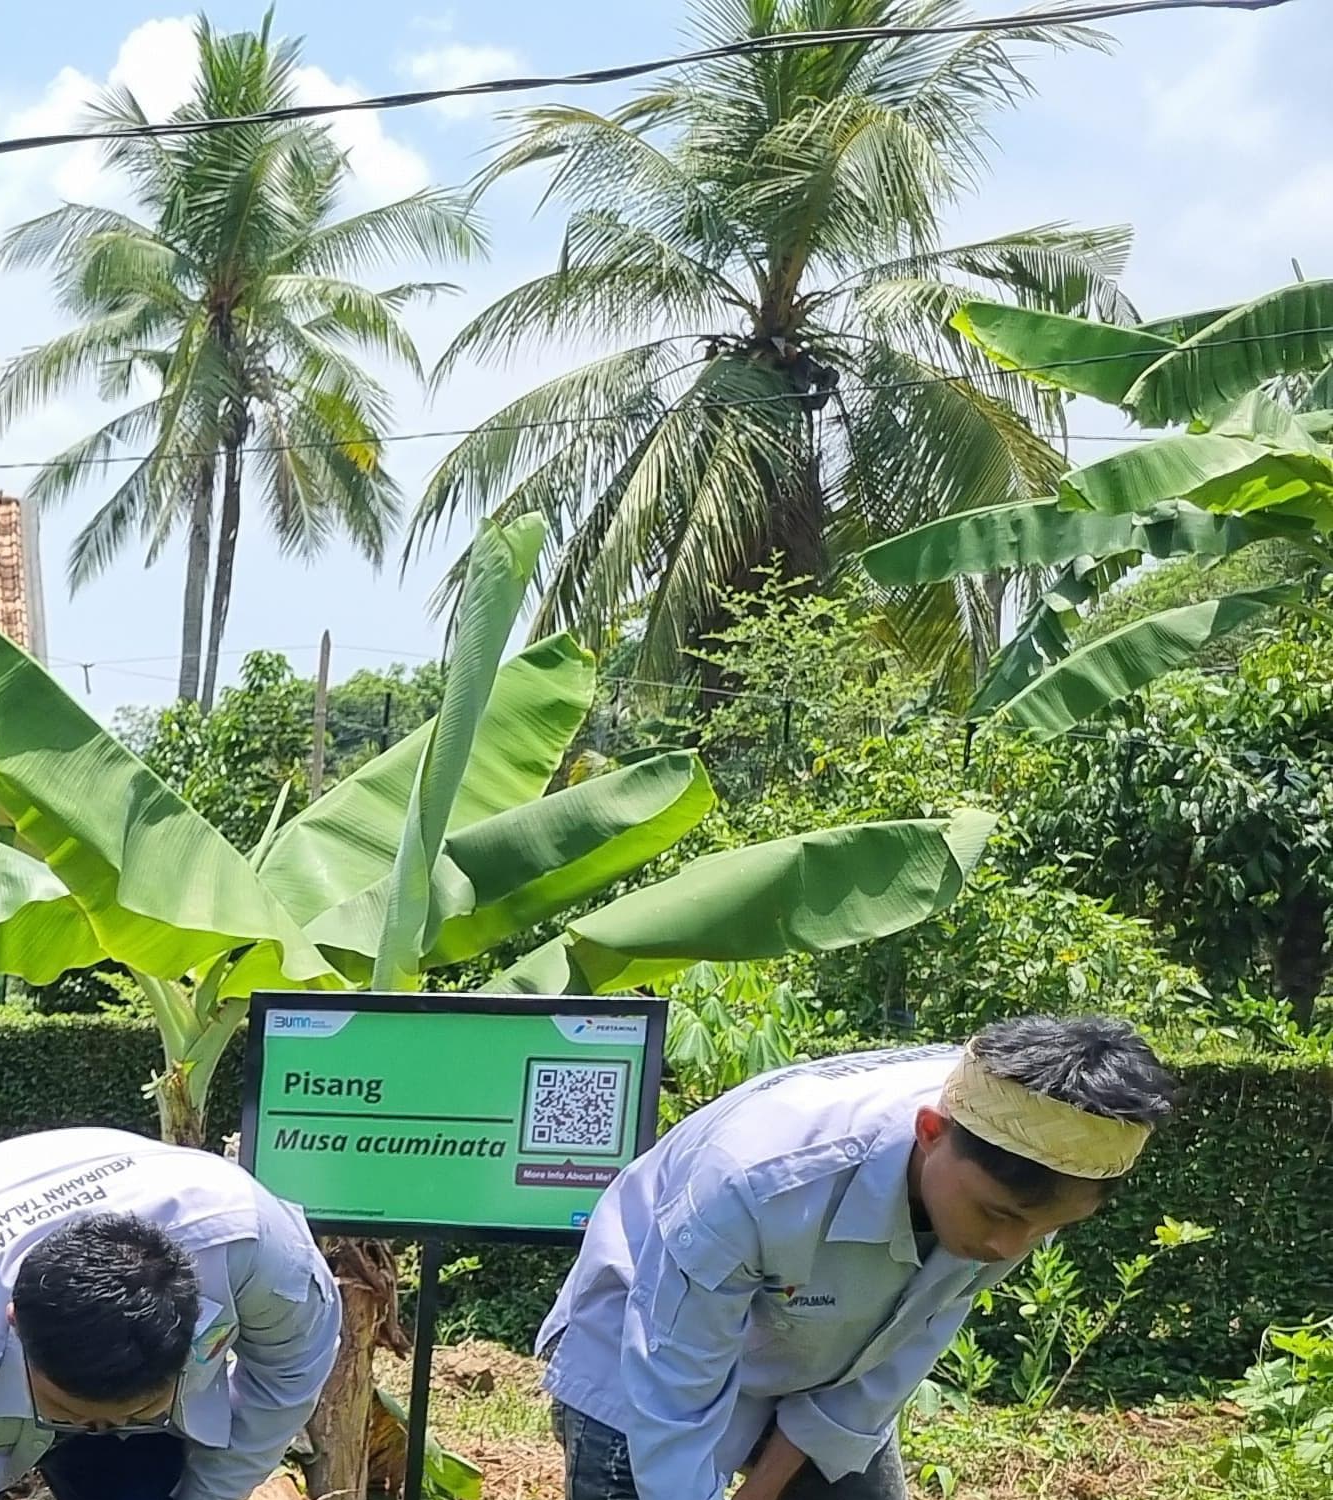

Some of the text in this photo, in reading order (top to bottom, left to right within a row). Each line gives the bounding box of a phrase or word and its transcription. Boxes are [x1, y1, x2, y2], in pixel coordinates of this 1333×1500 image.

[596, 1024, 638, 1033] PERTAMINA
[284, 1071, 384, 1102] Pisang
[274, 1128, 507, 1159] Musa acuminata
[42, 1157, 136, 1204] KELURAHAN
[523, 1169, 612, 1182] More Info About Me!
[22, 1186, 108, 1227] PEMUDA
